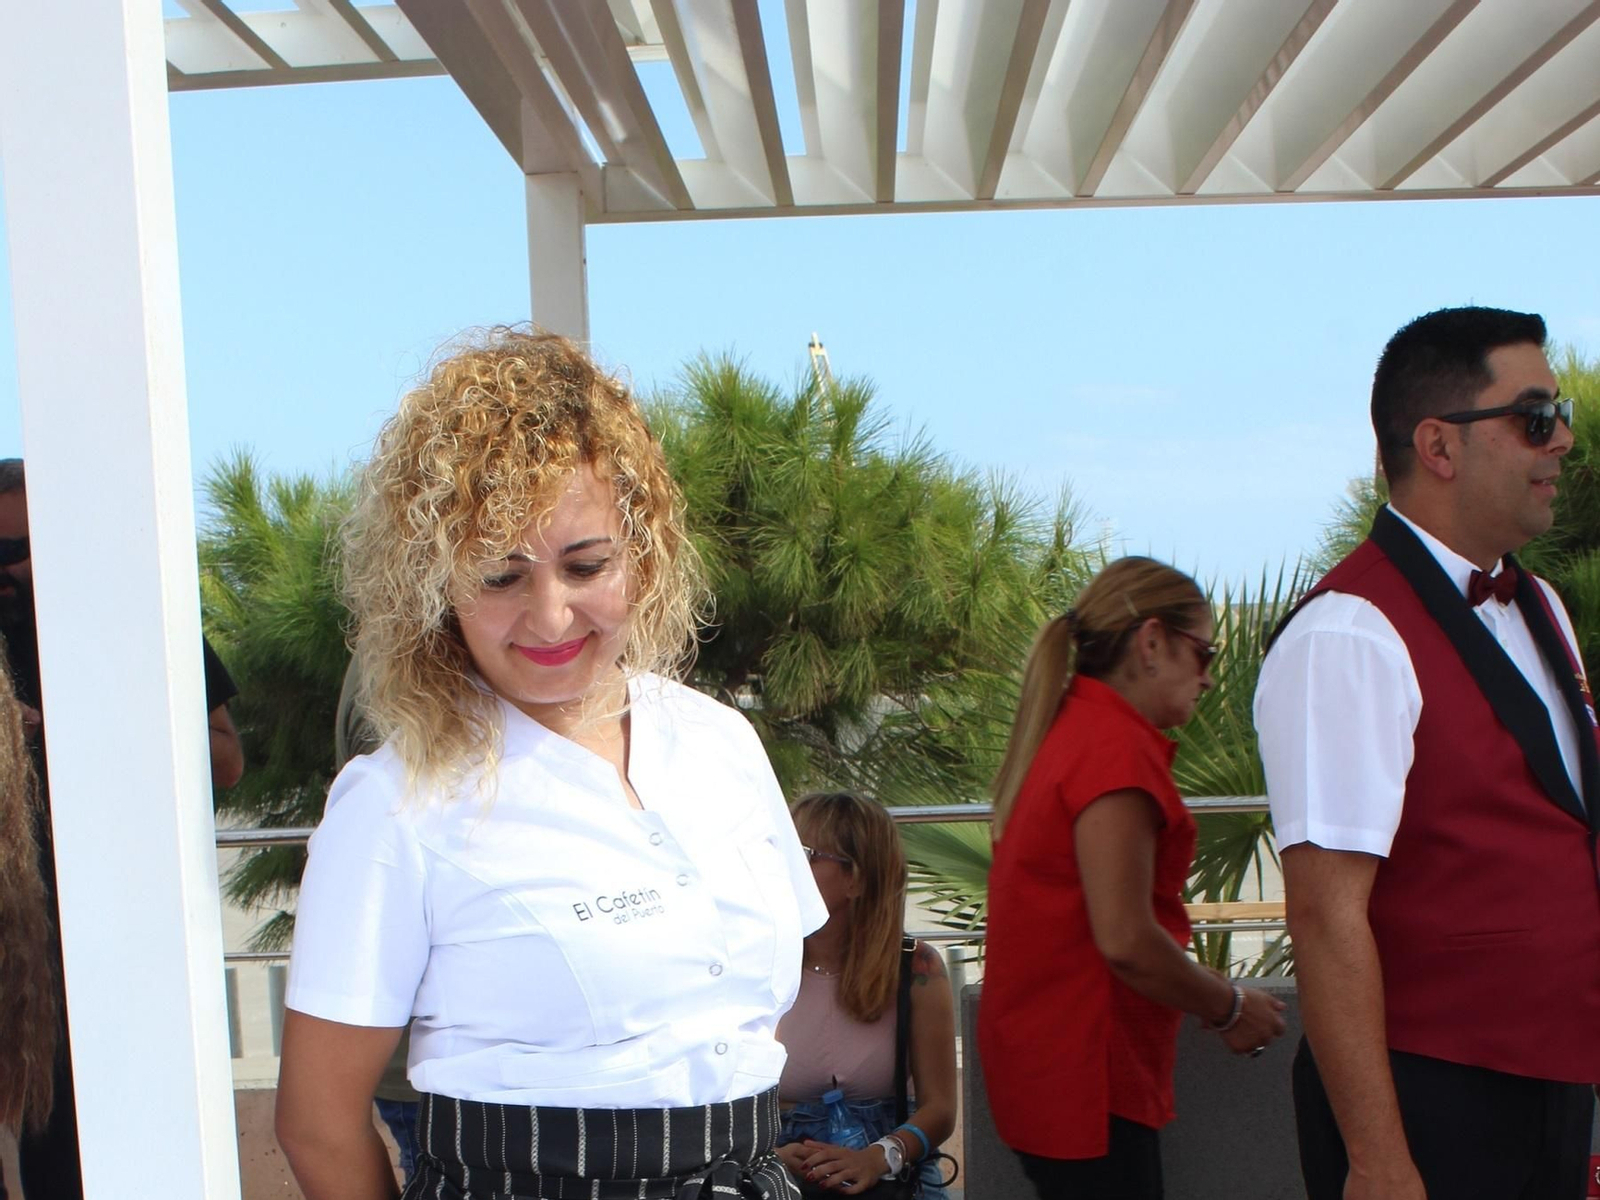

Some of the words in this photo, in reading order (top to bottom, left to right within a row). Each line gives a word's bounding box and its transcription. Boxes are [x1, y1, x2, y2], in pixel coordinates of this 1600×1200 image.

[572, 901, 593, 922] El
[613, 911, 631, 925] del
[631, 904, 665, 918] Puerto
